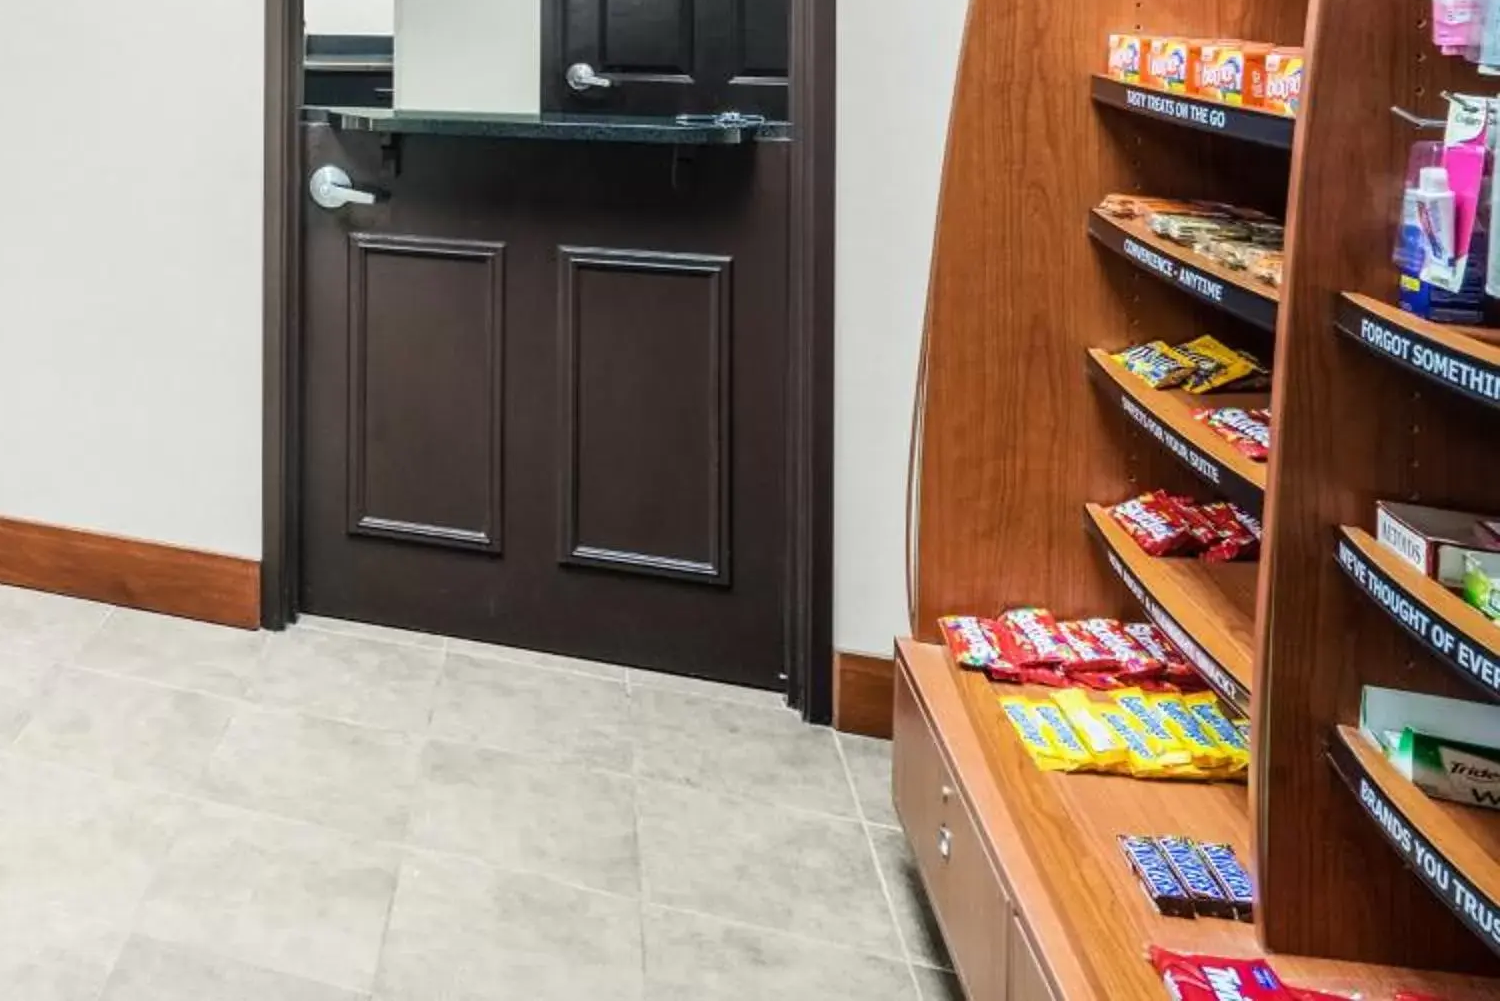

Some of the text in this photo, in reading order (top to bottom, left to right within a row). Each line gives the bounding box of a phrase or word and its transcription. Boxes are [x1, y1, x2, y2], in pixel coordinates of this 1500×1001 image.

[1146, 95, 1175, 116] TREATS
[1175, 102, 1189, 119] ON
[1190, 105, 1208, 123] THE
[1209, 109, 1225, 128] GO
[1178, 266, 1223, 301] ANYTIME
[1361, 318, 1411, 360] FORGOT
[1189, 452, 1221, 484] SUITE
[1339, 541, 1367, 584] WE'VE
[1367, 567, 1430, 636] THOUGHT
[1430, 624, 1455, 654] OF
[1360, 777, 1411, 851] BRANDS
[1413, 838, 1450, 890] YOU
